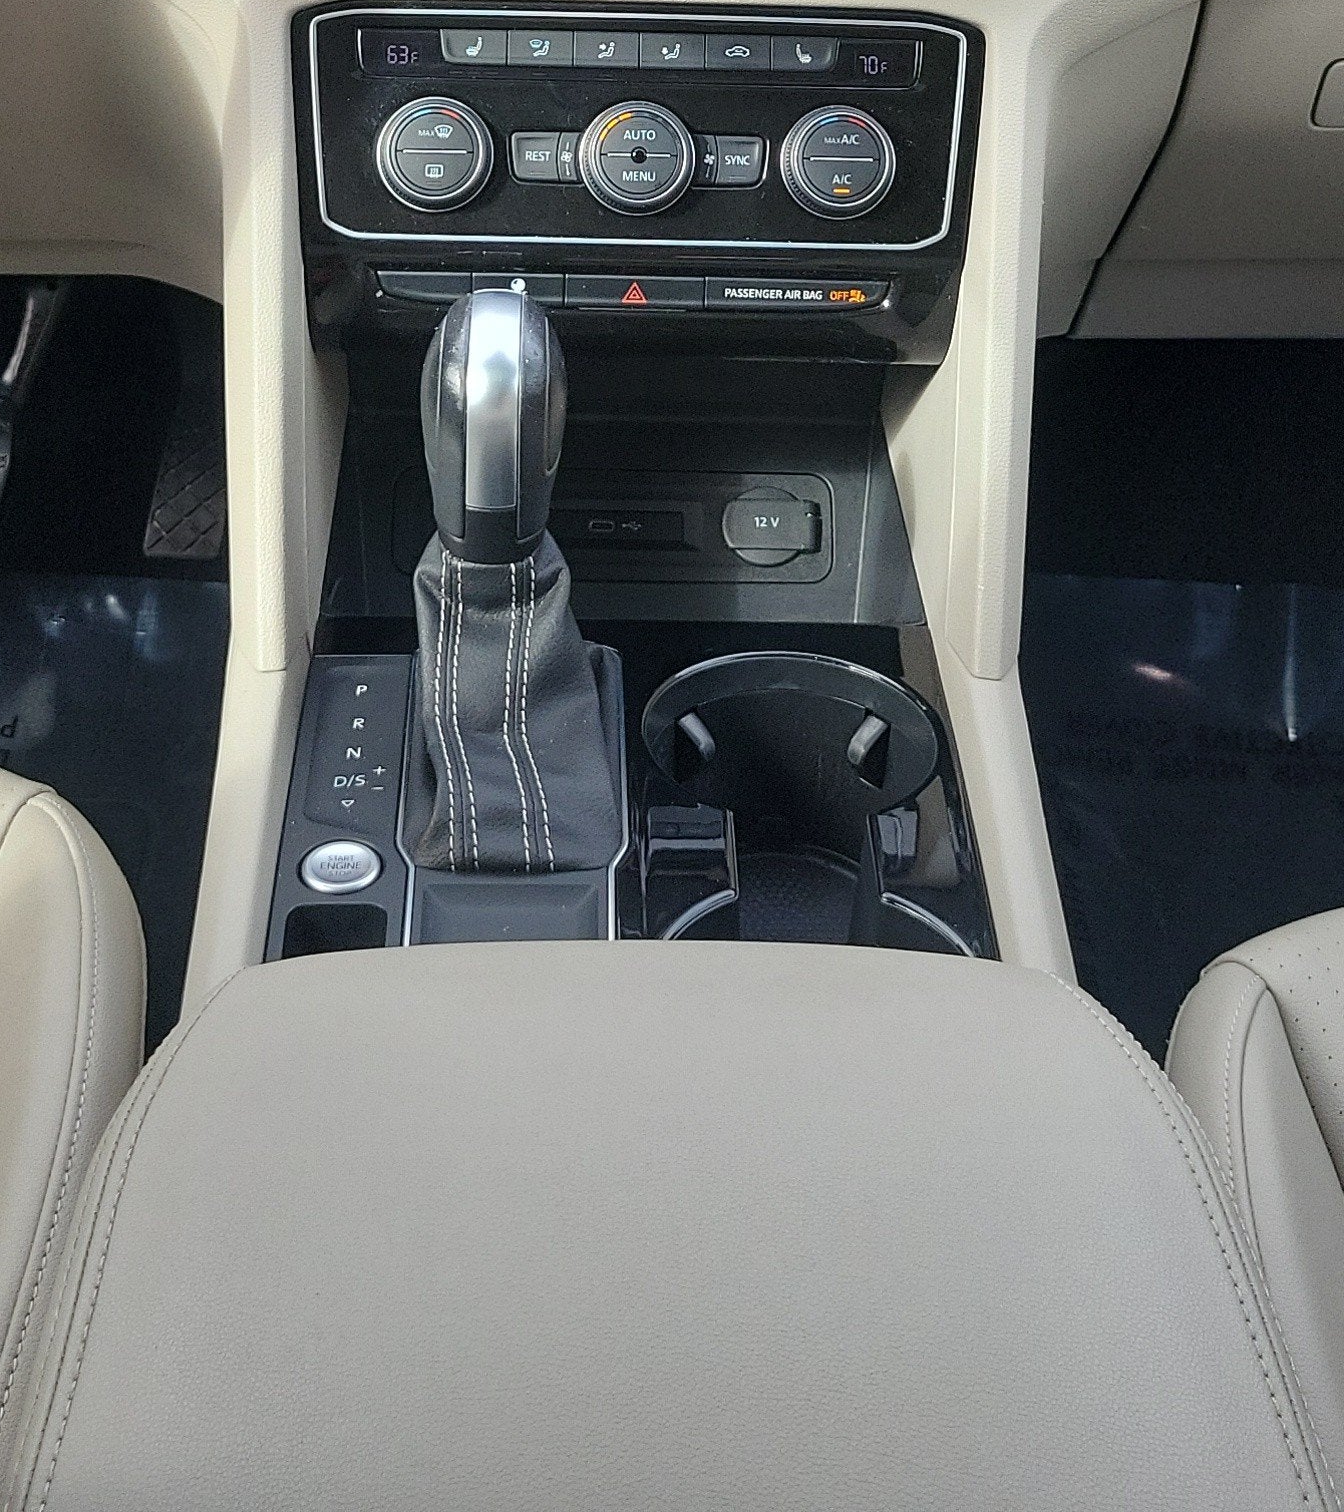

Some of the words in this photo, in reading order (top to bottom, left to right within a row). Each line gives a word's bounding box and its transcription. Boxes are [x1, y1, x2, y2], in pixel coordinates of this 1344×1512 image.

[418, 129, 435, 137] MAX
[623, 129, 656, 141] AUTO
[841, 134, 860, 146] A/C
[525, 151, 551, 162] REST
[725, 154, 750, 165] SYNC
[622, 170, 656, 182] MENU
[832, 174, 852, 185] A/C
[724, 288, 783, 299] PASSENGER
[784, 289, 801, 299] AIR
[802, 289, 823, 300] BAG
[829, 291, 850, 301] OFF
[755, 517, 768, 527] 12
[770, 517, 780, 528] V
[356, 685, 368, 696] P
[352, 718, 365, 729] R
[346, 747, 361, 758] N
[333, 775, 366, 787] D/S
[320, 861, 362, 869] ENGINE
